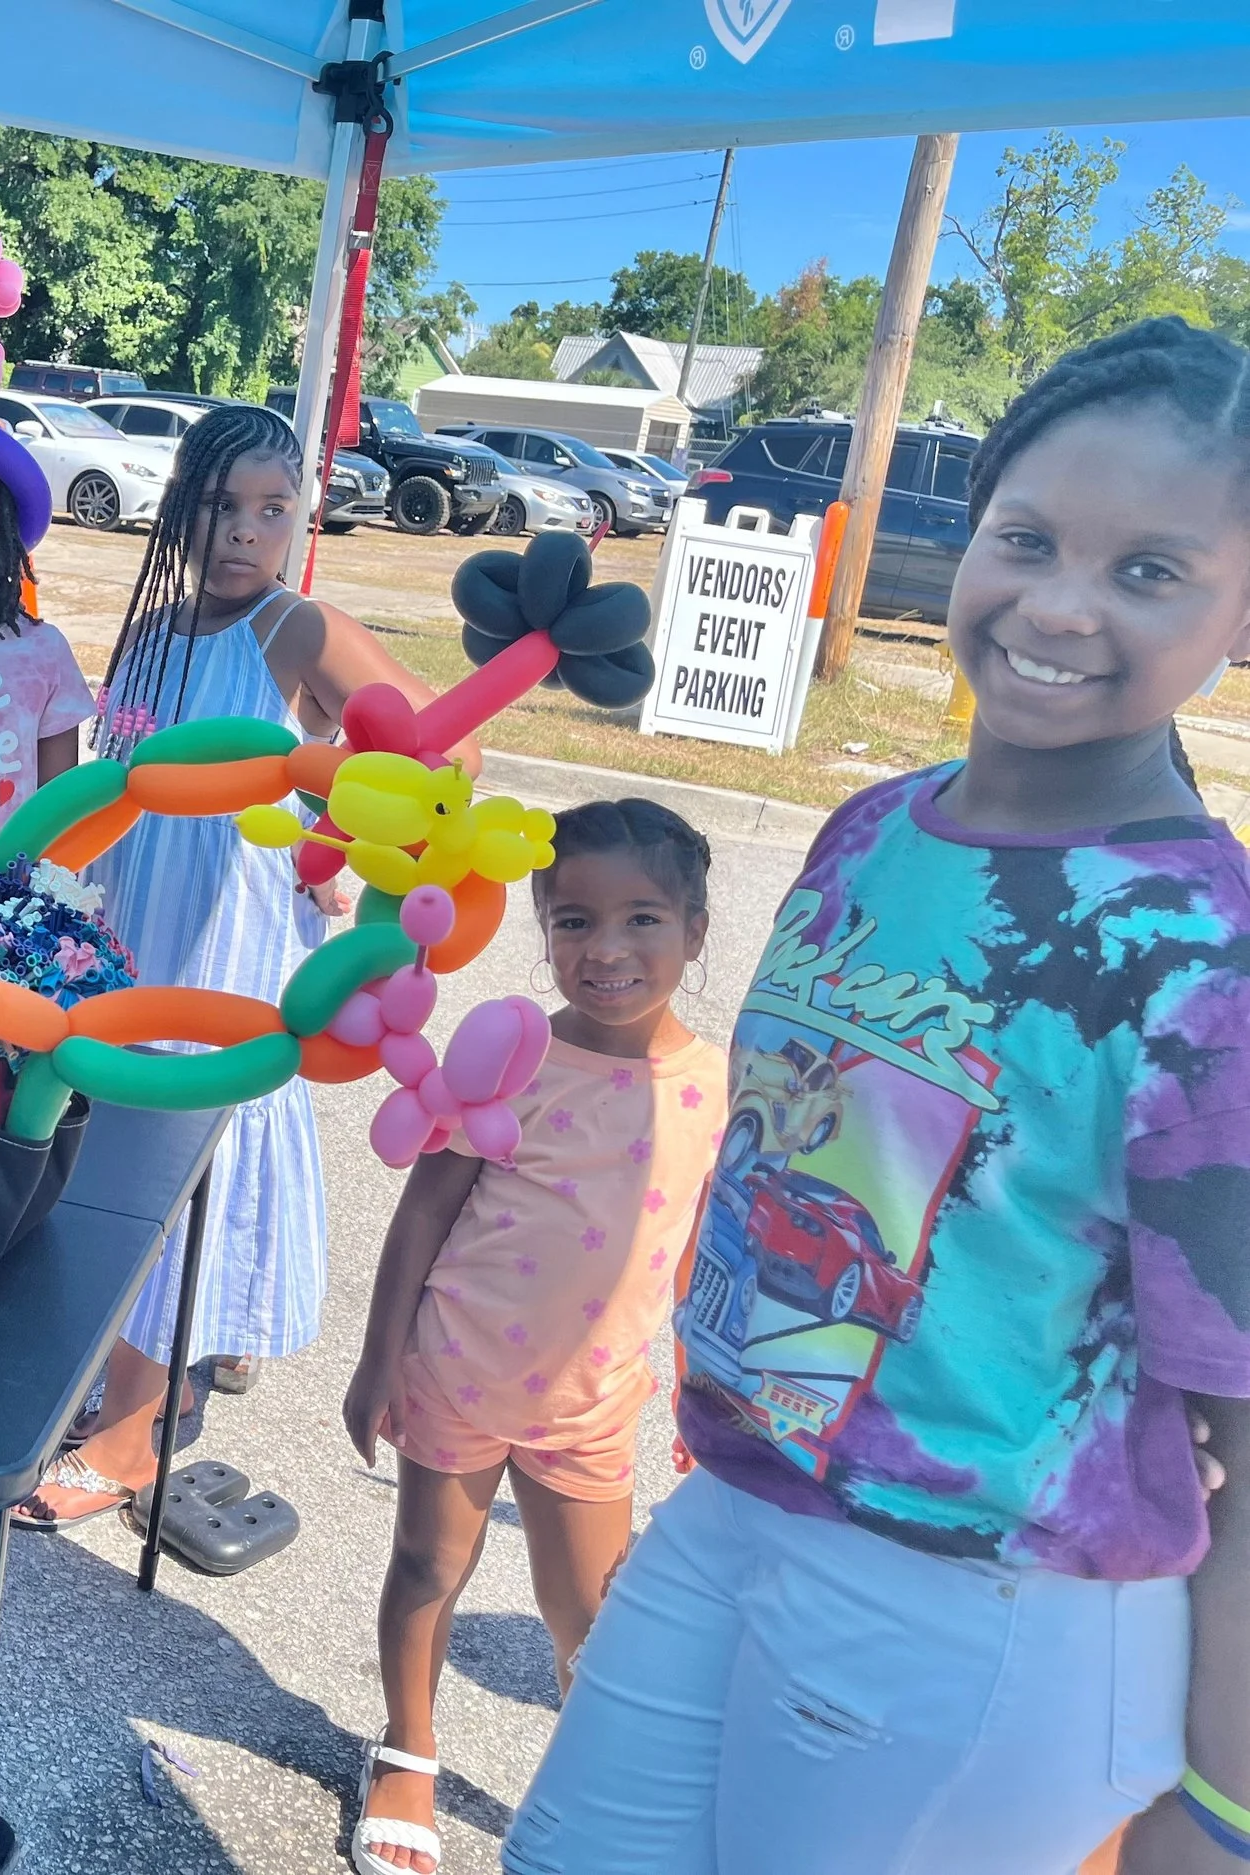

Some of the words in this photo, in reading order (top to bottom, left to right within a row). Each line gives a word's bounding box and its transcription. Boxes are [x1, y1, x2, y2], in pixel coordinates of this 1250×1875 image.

[687, 555, 796, 614] VENDORS/
[694, 613, 766, 660] EVENT
[671, 665, 767, 718] PARKING
[769, 1390, 815, 1417] BEST
